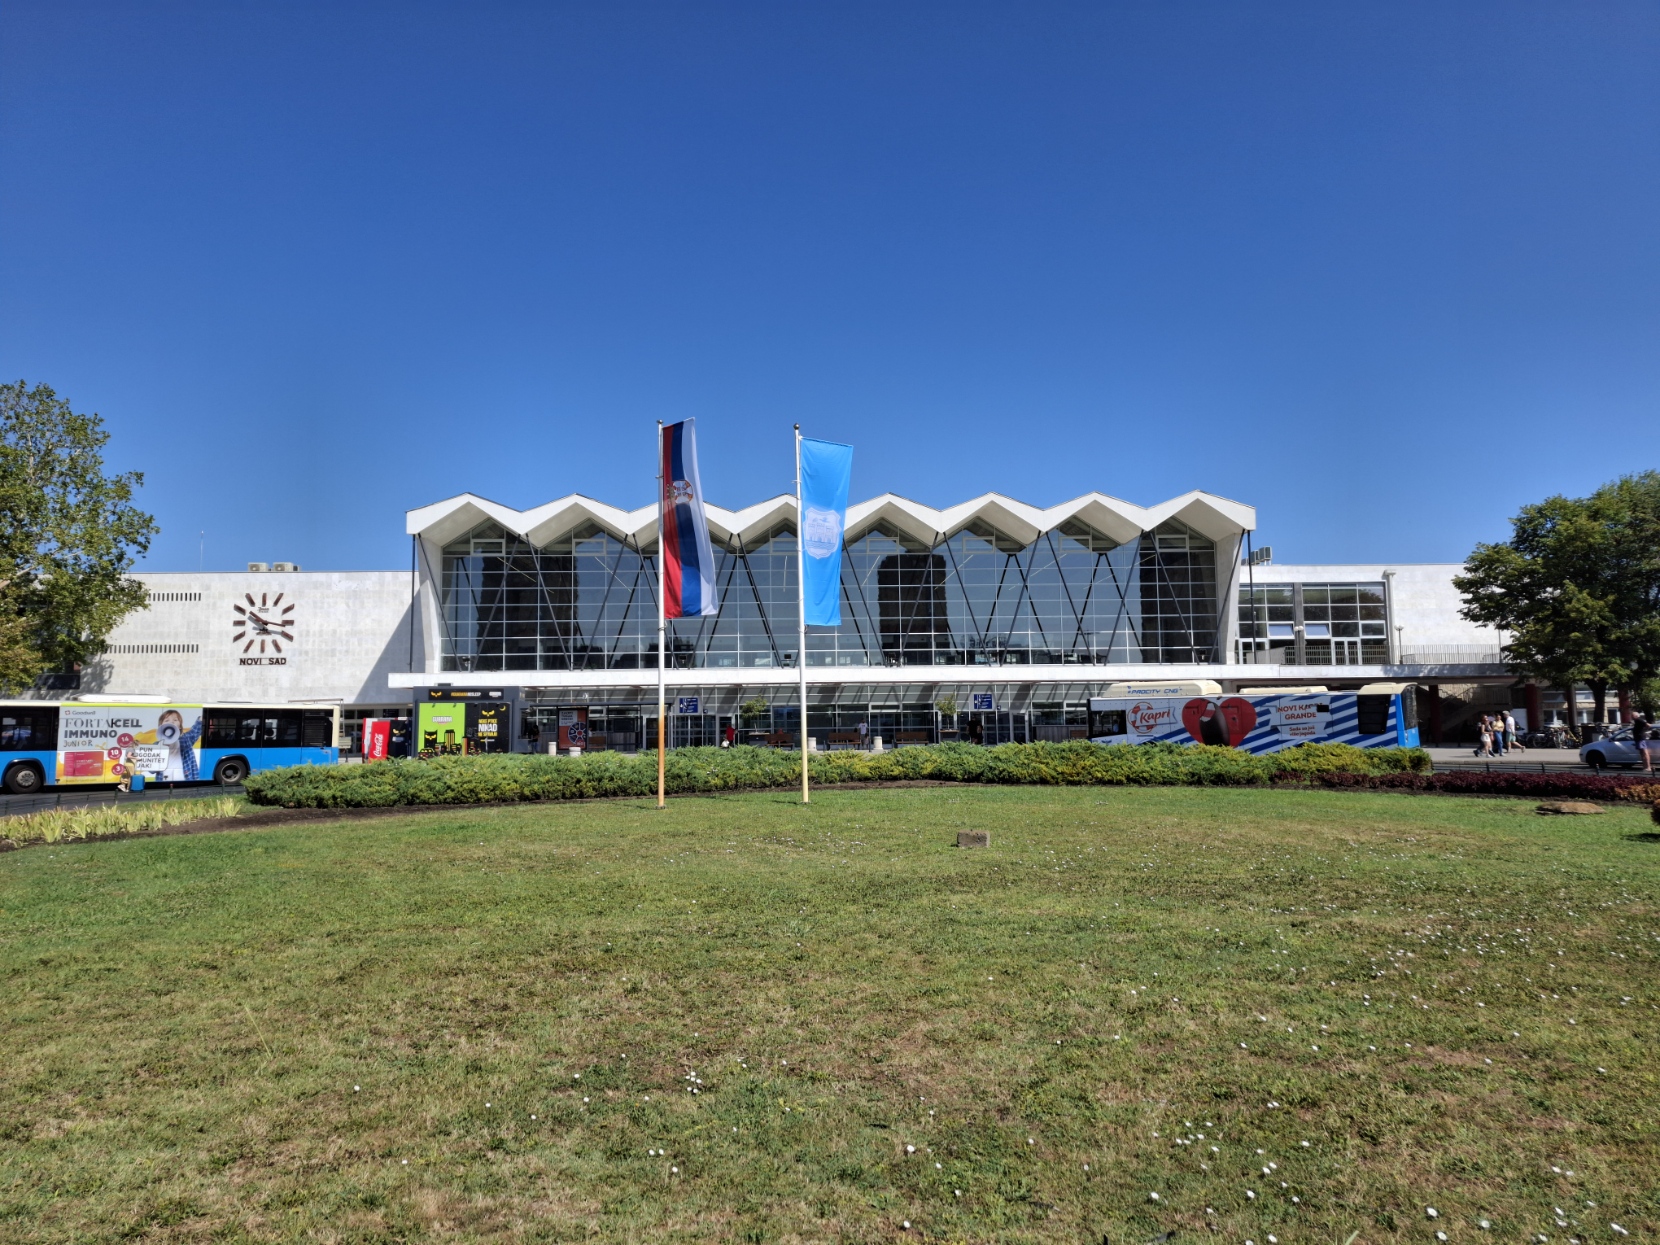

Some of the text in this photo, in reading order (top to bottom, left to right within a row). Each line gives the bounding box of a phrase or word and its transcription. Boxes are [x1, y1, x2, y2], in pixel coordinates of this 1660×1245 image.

[1277, 704, 1296, 712] NOVI
[1140, 708, 1170, 724] Kapri
[1284, 712, 1316, 720] GRANDE
[478, 724, 498, 732] NIKAD
[64, 730, 118, 738] IMMUNO
